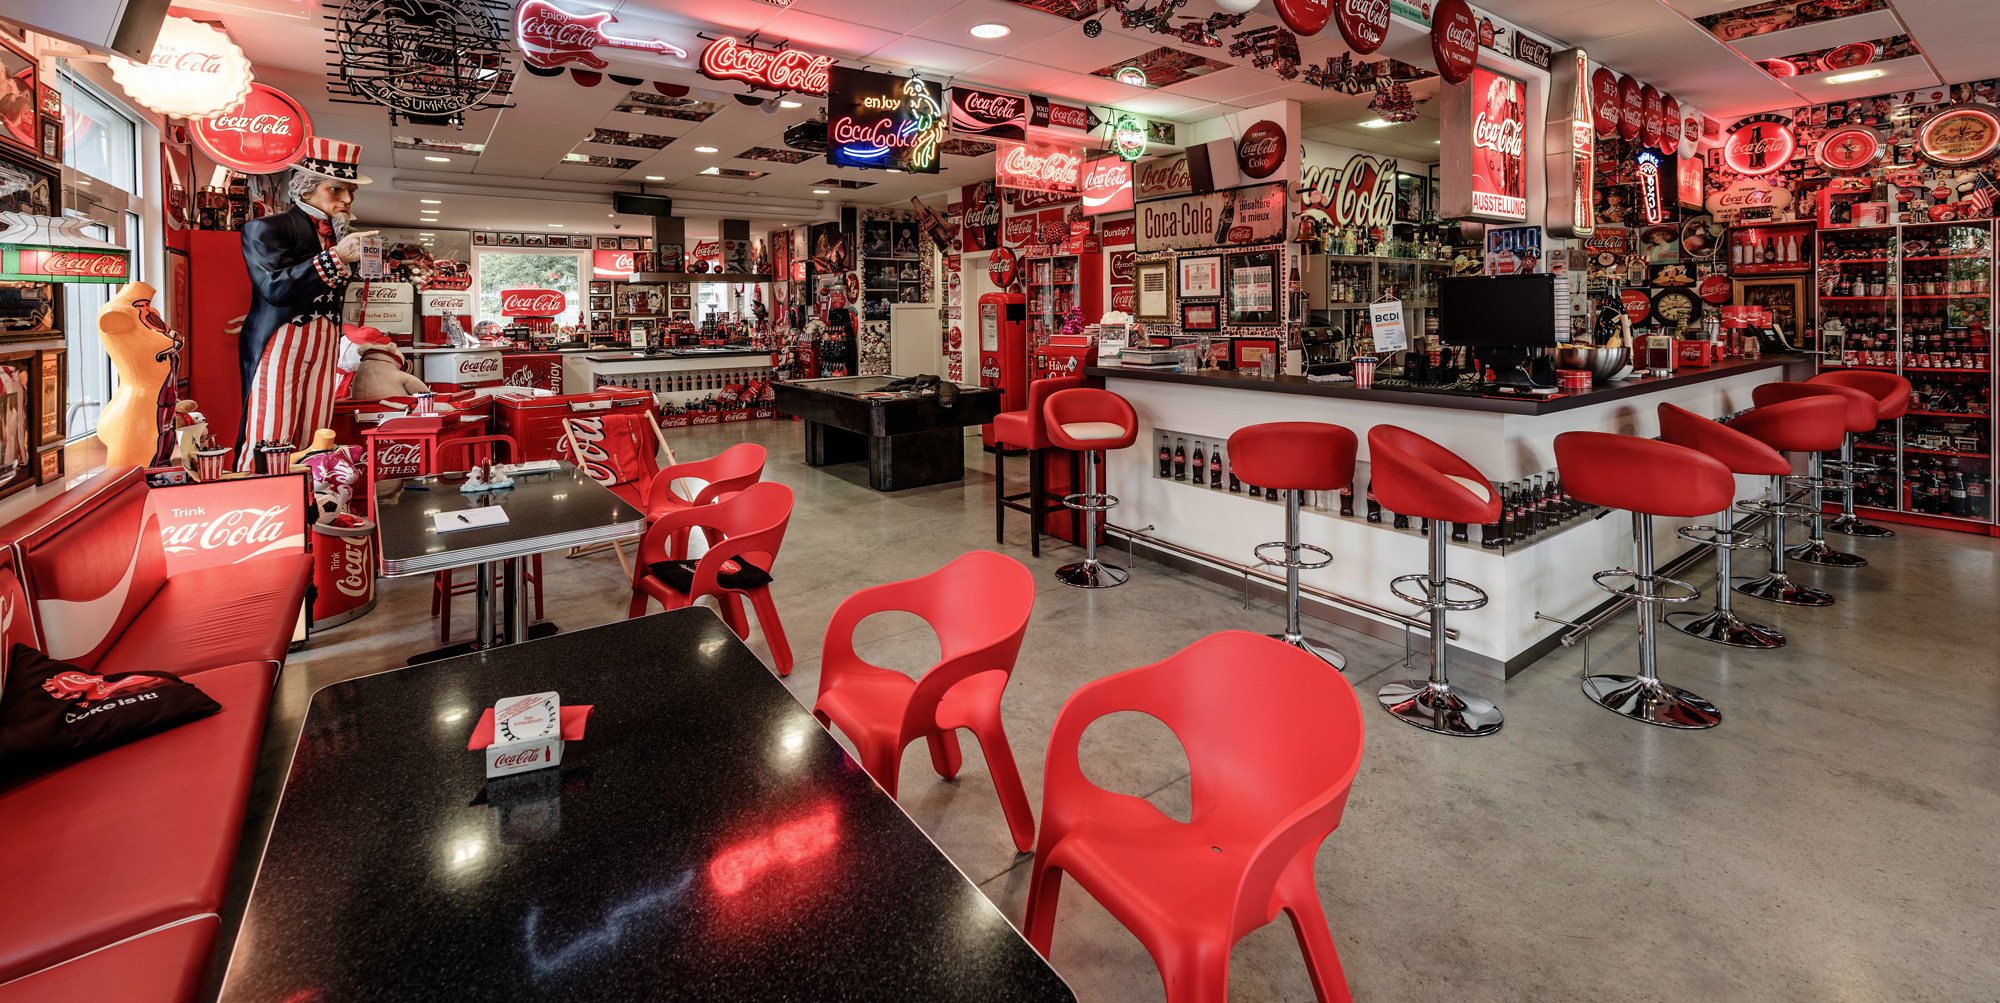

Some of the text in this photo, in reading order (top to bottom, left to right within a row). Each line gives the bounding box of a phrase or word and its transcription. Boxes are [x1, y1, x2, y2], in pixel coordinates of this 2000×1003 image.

[540, 8, 568, 23] Enjoy
[1346, 0, 1388, 29] Coca-Cola
[519, 17, 597, 48] Coca-Cola
[1358, 23, 1378, 44] Coke
[1446, 22, 1476, 52] Coca-Cola
[128, 53, 224, 73] ca-Cola
[1520, 38, 1549, 68] Coca-Cola
[704, 37, 833, 92] Coca-Cola
[864, 95, 901, 111] enjoy
[965, 92, 1018, 118] Coca-Cola
[1036, 105, 1049, 113] SOLD
[1037, 111, 1049, 119] HERE
[1050, 107, 1085, 128] Coca-Cola
[1731, 114, 1787, 132] ALWAYS
[209, 114, 292, 137] Coca-Cola
[1473, 111, 1523, 157] Coca-Cola
[1241, 137, 1278, 158] Coca-Cola
[1731, 136, 1786, 157] Coca-Cola
[1005, 147, 1081, 184] Coca-Cola
[1249, 157, 1270, 169] Coke
[1085, 165, 1128, 190] Coca-Cola
[1141, 158, 1191, 193] Coca-Co
[1300, 150, 1397, 229] ca-Cola
[1720, 190, 1773, 206] Coca-Cola
[1240, 198, 1271, 212] désaltère
[1473, 194, 1525, 216] AUSSTELLUNG
[965, 203, 1000, 229] Coca-Cola
[1144, 201, 1213, 240] Coca-Cola
[1248, 211, 1270, 225] mieux
[1007, 219, 1033, 236] Coca-Cola
[1104, 226, 1130, 239] Durstig?
[363, 245, 380, 254] BCDI
[1489, 228, 1538, 252] COLD
[1584, 235, 1624, 249] Coca-Cola
[44, 252, 124, 276] Coca-Cola
[988, 258, 1017, 275] Coca-Cola
[355, 286, 399, 299] Cca-Cola
[430, 299, 464, 309] Coca-Cola
[503, 294, 562, 312] Coca-Cola
[1375, 310, 1400, 325] BCDI
[459, 358, 500, 374] Coca-Cola
[1049, 361, 1069, 375] Have
[547, 362, 562, 397] enjoy
[661, 418, 688, 429] Coca-Cola
[693, 416, 719, 426] Coca-Cola
[725, 412, 749, 424] Coca-Cola
[756, 411, 772, 421] Coke
[171, 505, 206, 519] Trink
[161, 503, 292, 553] ca-Cola
[331, 551, 342, 572] Trink
[336, 534, 369, 597] Coca-C
[494, 747, 541, 769] Coca-Cola
